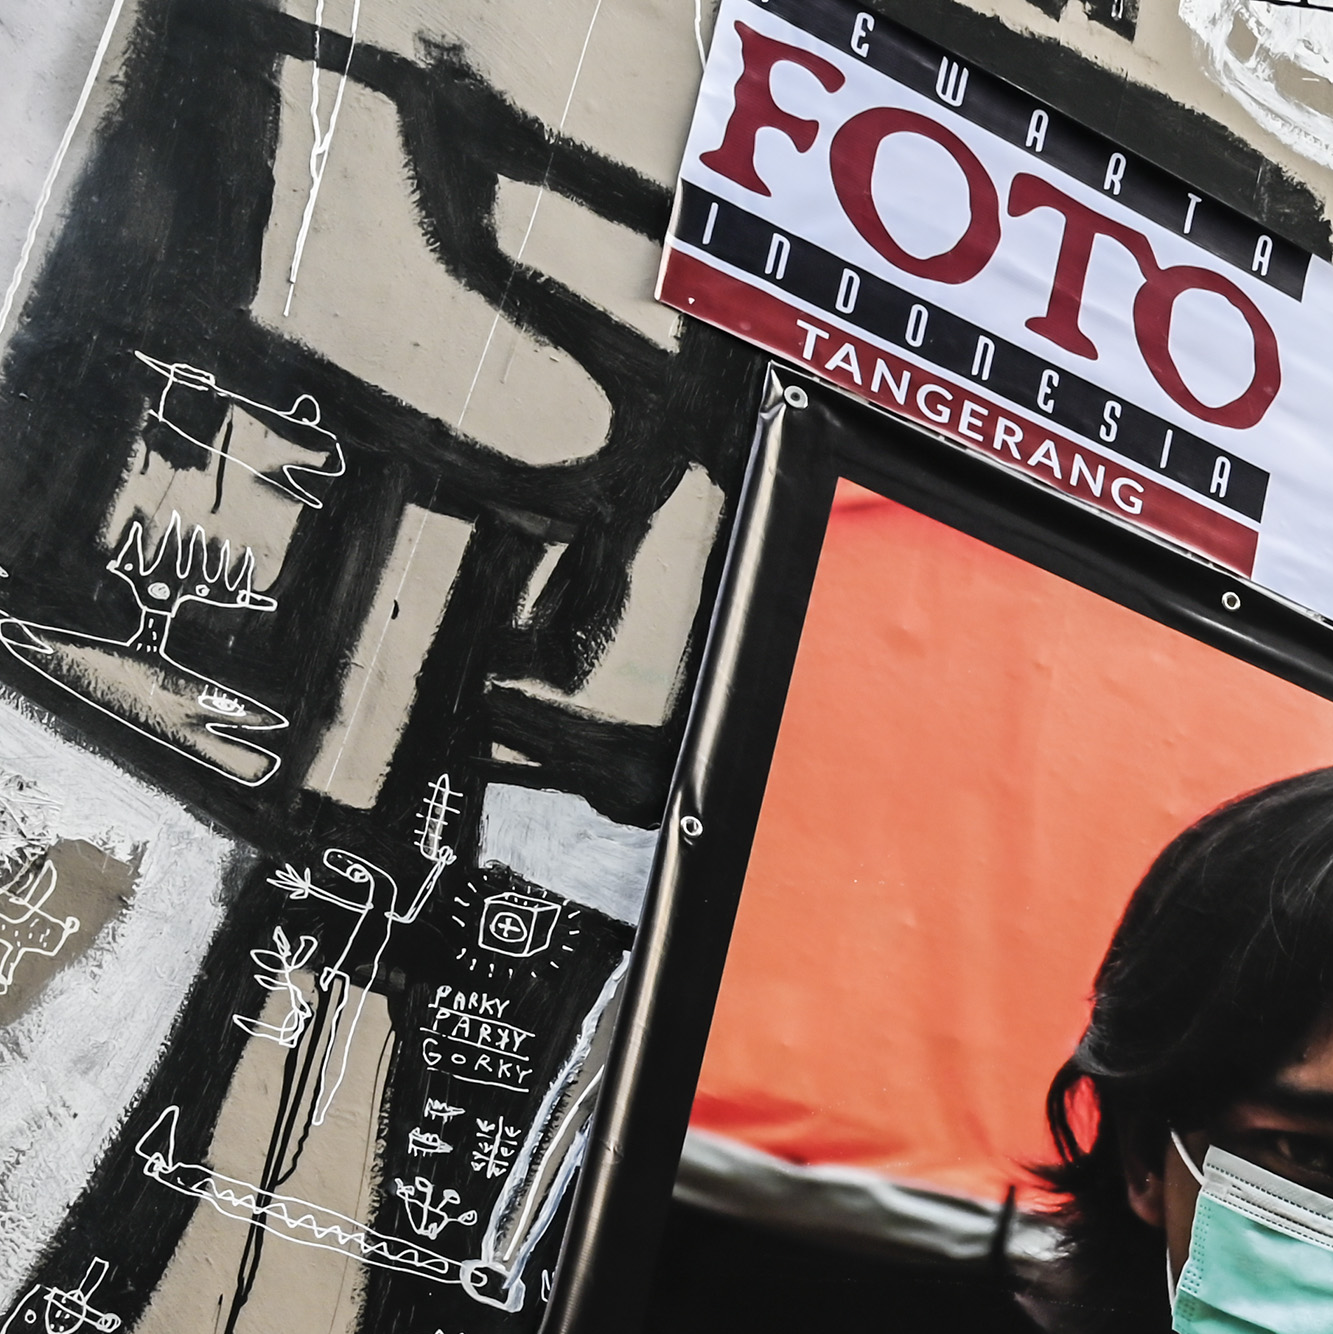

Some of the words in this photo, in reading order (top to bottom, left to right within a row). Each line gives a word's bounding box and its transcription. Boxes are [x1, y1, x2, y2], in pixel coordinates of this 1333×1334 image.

[700, 20, 1281, 429] FOTO
[761, 0, 1273, 276] EWARTA
[702, 201, 1231, 498] INDONESIA
[796, 320, 1144, 515] TANGERANG
[422, 1038, 532, 1084] GORKY
